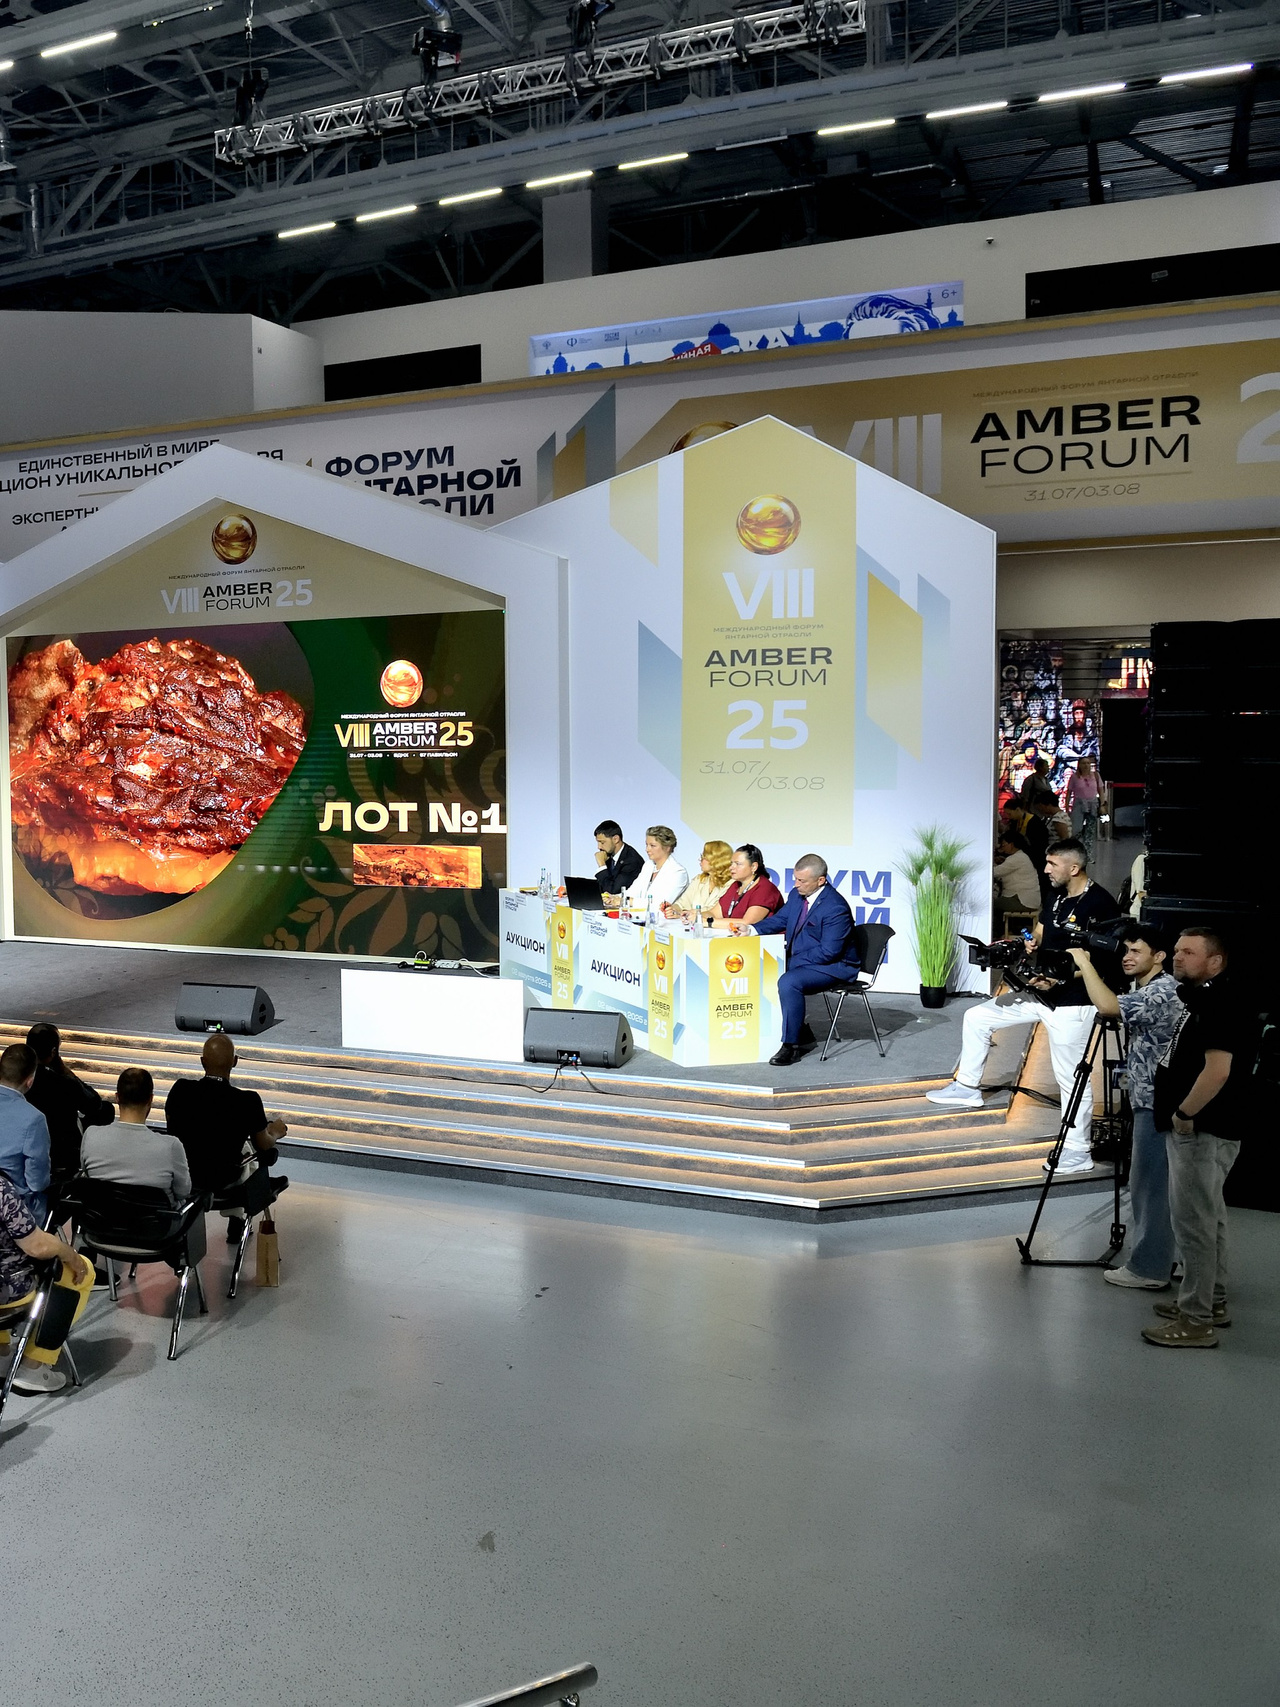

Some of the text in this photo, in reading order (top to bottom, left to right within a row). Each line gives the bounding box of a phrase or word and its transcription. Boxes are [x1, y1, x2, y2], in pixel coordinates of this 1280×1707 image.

[941, 288, 958, 300] 6+
[970, 395, 1202, 444] AMBER
[18, 443, 153, 474] ЕДИНСТВЕННЫЙ
[156, 445, 168, 457] В
[325, 445, 455, 478] ФОРУМ
[980, 433, 1190, 478] FORUM
[1024, 482, 1141, 502] 31.07/03.08
[12, 506, 99, 526] ЭКСПЕРТН
[168, 571, 221, 580] МЕЖДУНАРОДНЫЙ
[244, 566, 276, 574] ЯНТАРНОЙ
[202, 581, 274, 599] AMBER
[275, 579, 314, 607] 25
[722, 568, 815, 620] VIII
[160, 587, 200, 614] VIII
[205, 596, 271, 612] FORUM
[713, 624, 791, 633] МЕЖДУНАРОДНЫЙ
[724, 631, 812, 640] ЯНТАРНОЙ ОТРАСЛИ
[704, 647, 833, 668] AMBER
[709, 668, 827, 688] FORUM
[372, 722, 438, 735] AMBER
[439, 721, 474, 747] 25
[726, 699, 809, 750] 25
[334, 723, 370, 748] VIII
[375, 735, 435, 747] FORUM
[699, 760, 771, 776] 31.07/
[746, 776, 825, 791] /03.08
[319, 801, 508, 834] ЛОТ №1
[505, 931, 546, 955] АУКЦИОН
[554, 964, 571, 975] AMBER
[591, 959, 641, 987] АУКЦИОН
[556, 981, 568, 1000] 25
[721, 977, 748, 996] VIII
[651, 999, 671, 1012] AMBER
[715, 1003, 753, 1012] AMBER
[717, 1010, 752, 1019] FORUM
[627, 1011, 643, 1024] 2025
[654, 1018, 667, 1039] 25
[721, 1020, 747, 1039] 25
